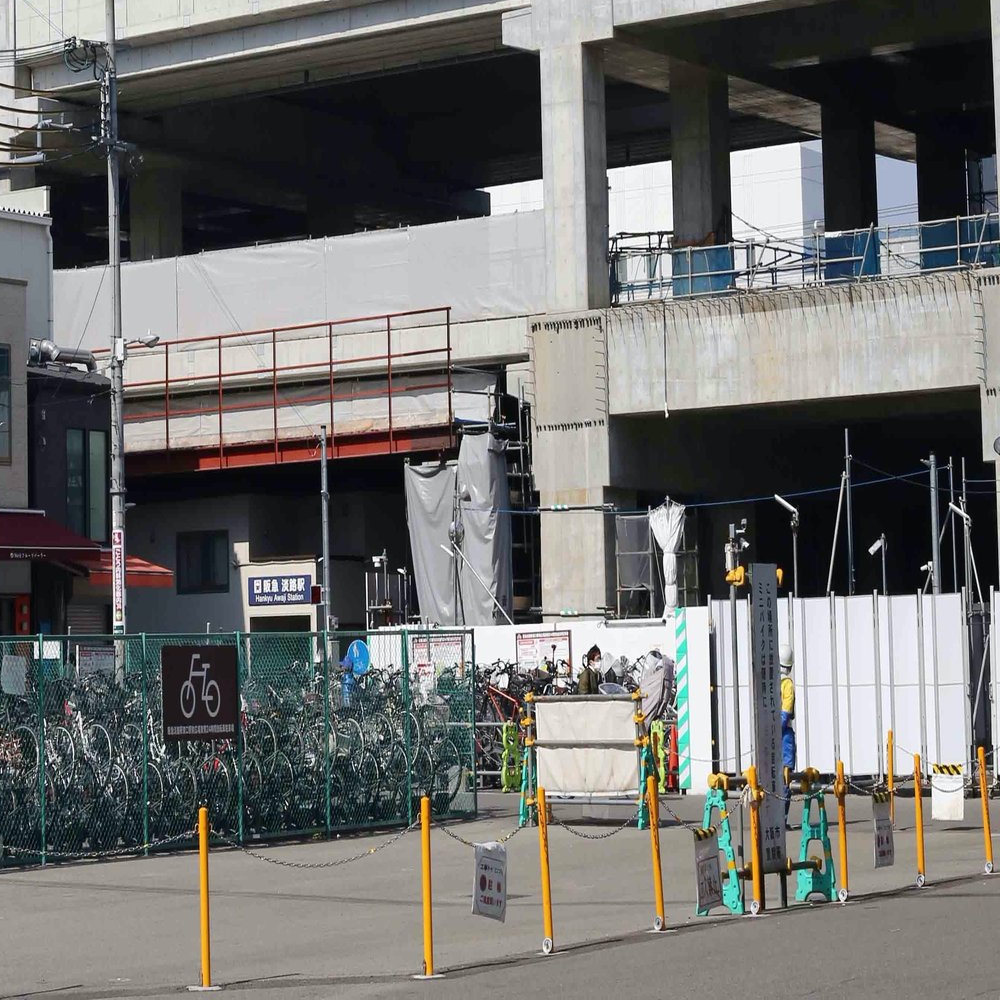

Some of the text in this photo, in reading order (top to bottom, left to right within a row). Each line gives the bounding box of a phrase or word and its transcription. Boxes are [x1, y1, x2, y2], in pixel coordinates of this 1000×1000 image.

[263, 578, 305, 592] 阪急 淡路駅
[255, 592, 304, 603] Hankyu Awaji Station
